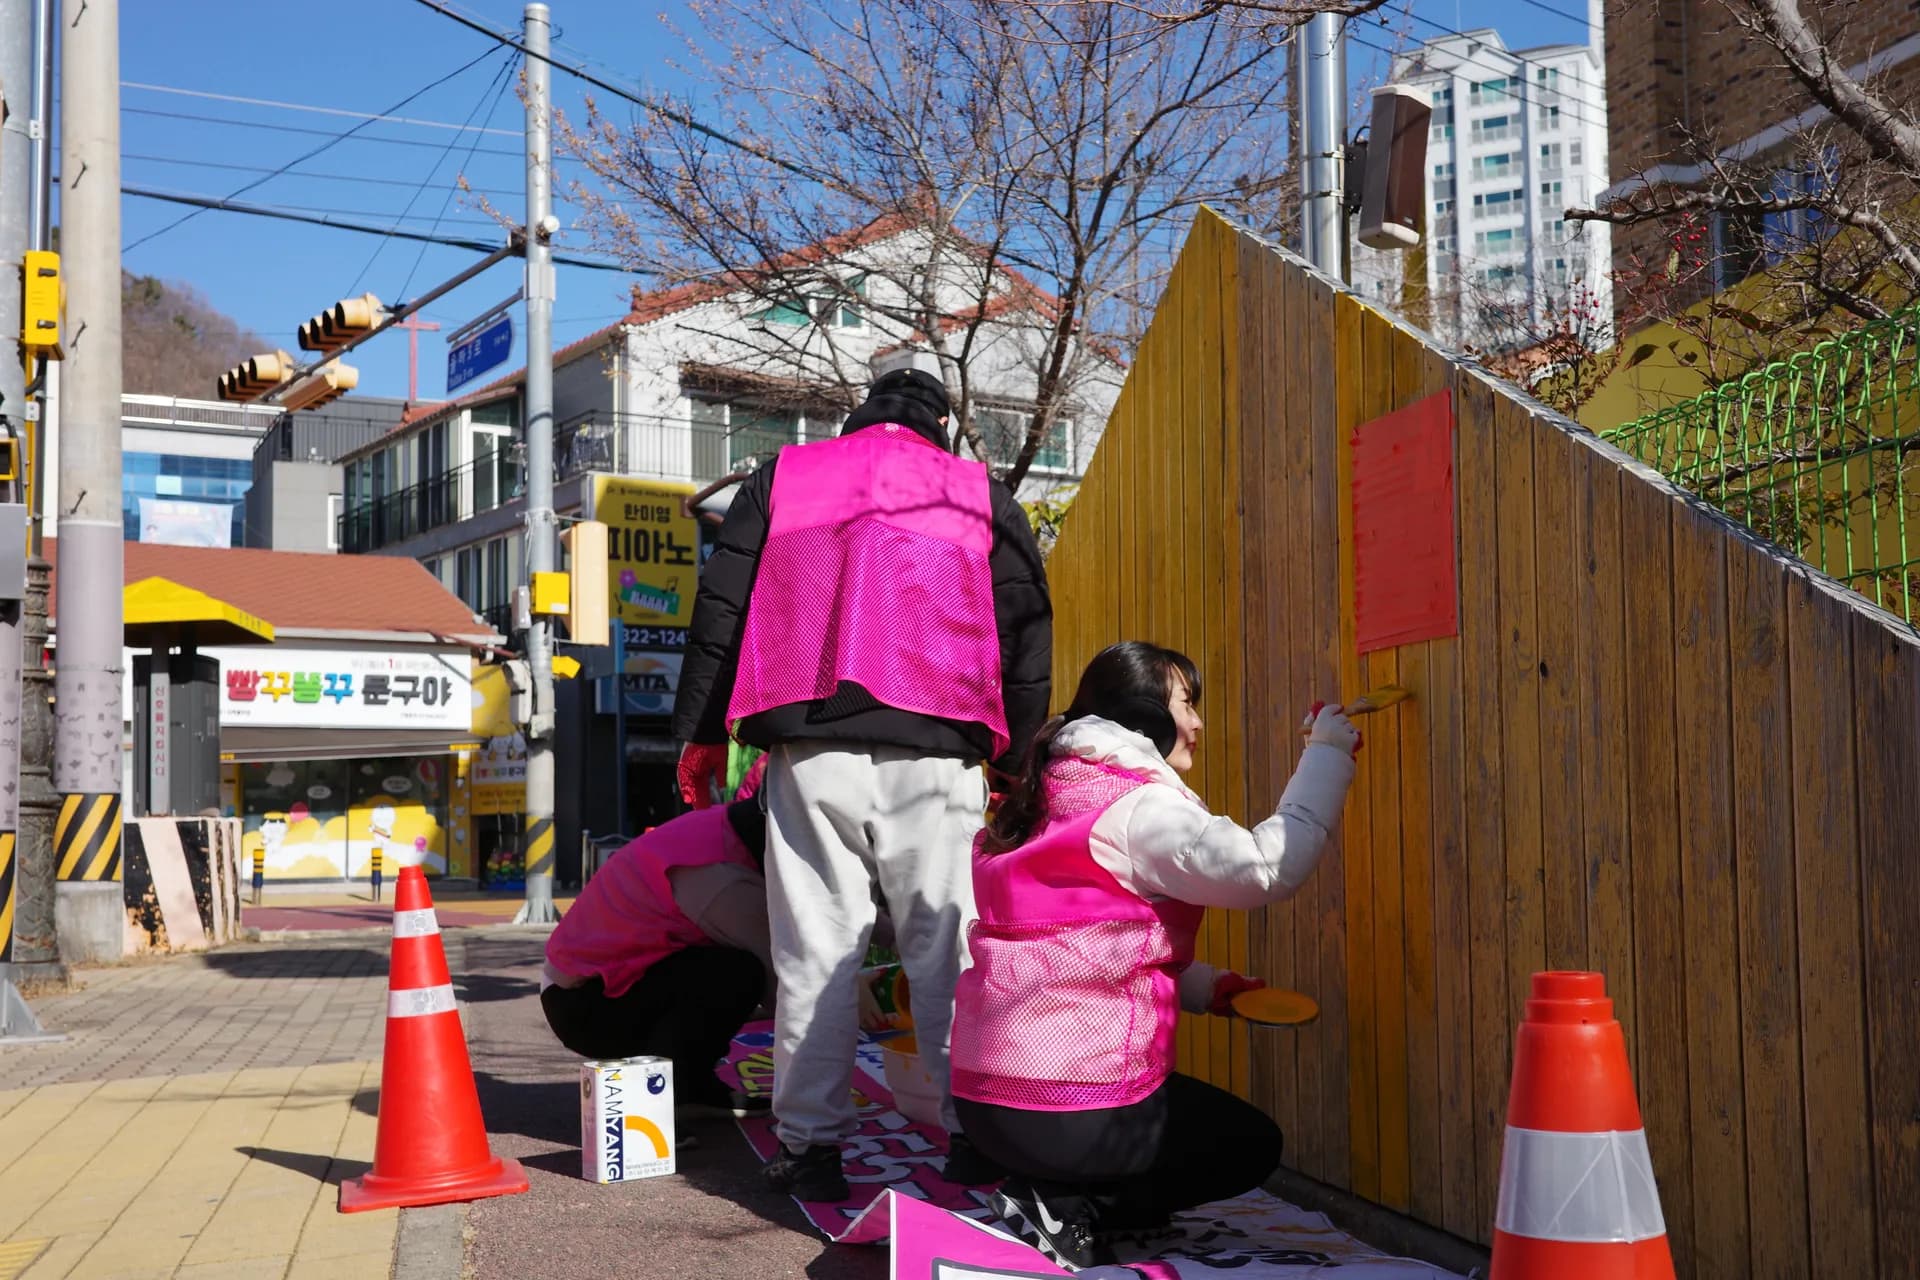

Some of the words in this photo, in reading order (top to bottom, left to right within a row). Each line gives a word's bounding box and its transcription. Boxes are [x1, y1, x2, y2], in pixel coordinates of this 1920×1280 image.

[624, 503, 671, 523] 한미영
[608, 527, 694, 566] 피아노
[623, 628, 691, 644] 322-124
[362, 674, 453, 706] 문구야
[604, 1068, 624, 1181] NAMYANG
